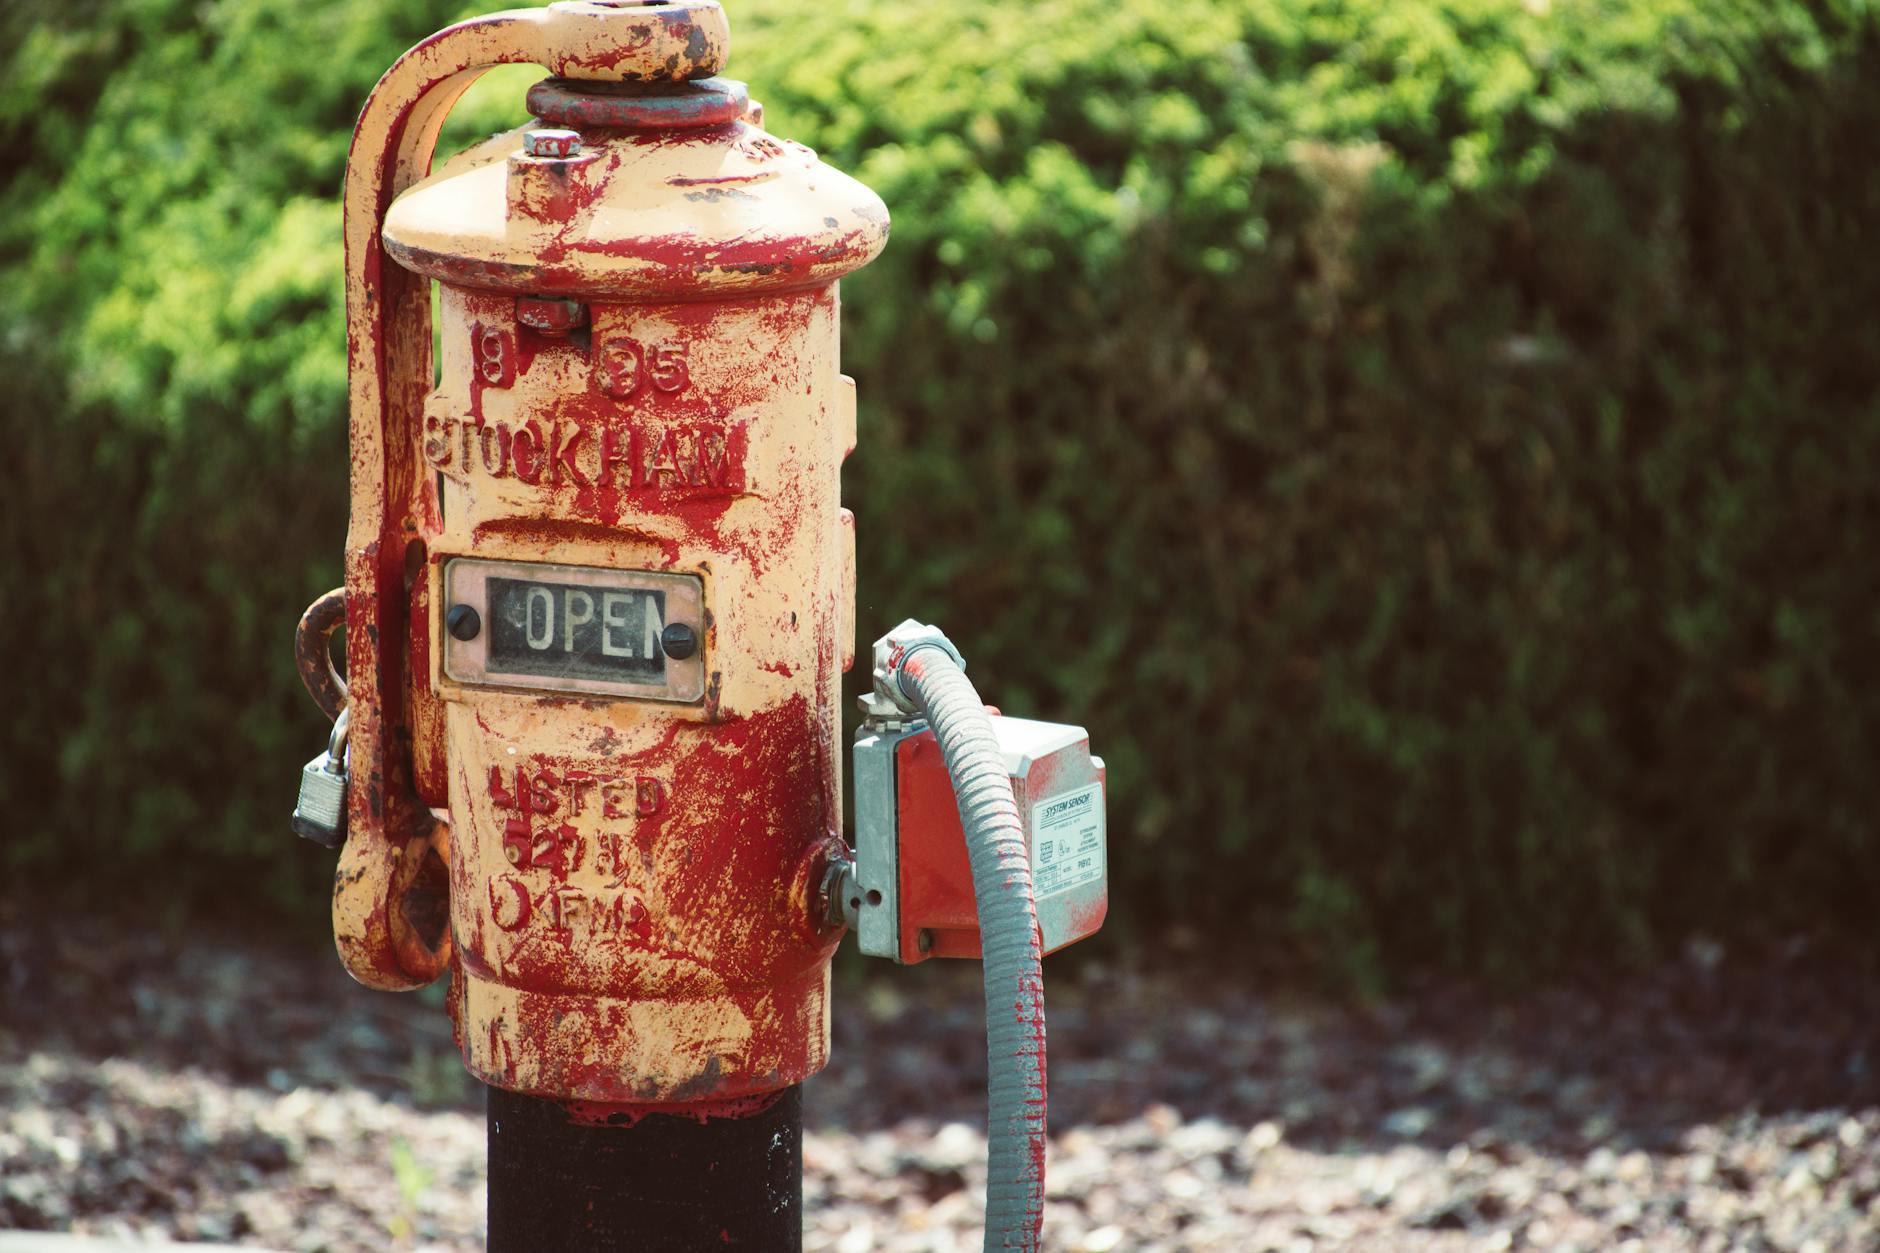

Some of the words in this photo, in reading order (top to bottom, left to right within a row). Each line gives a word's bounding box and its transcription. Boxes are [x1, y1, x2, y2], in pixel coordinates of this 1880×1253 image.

[424, 414, 747, 489] STOCKHAM
[526, 586, 667, 660] OPEN
[488, 764, 667, 819] LISTED
[1046, 801, 1068, 817] SYSTEM
[1068, 793, 1091, 809] SENSOR
